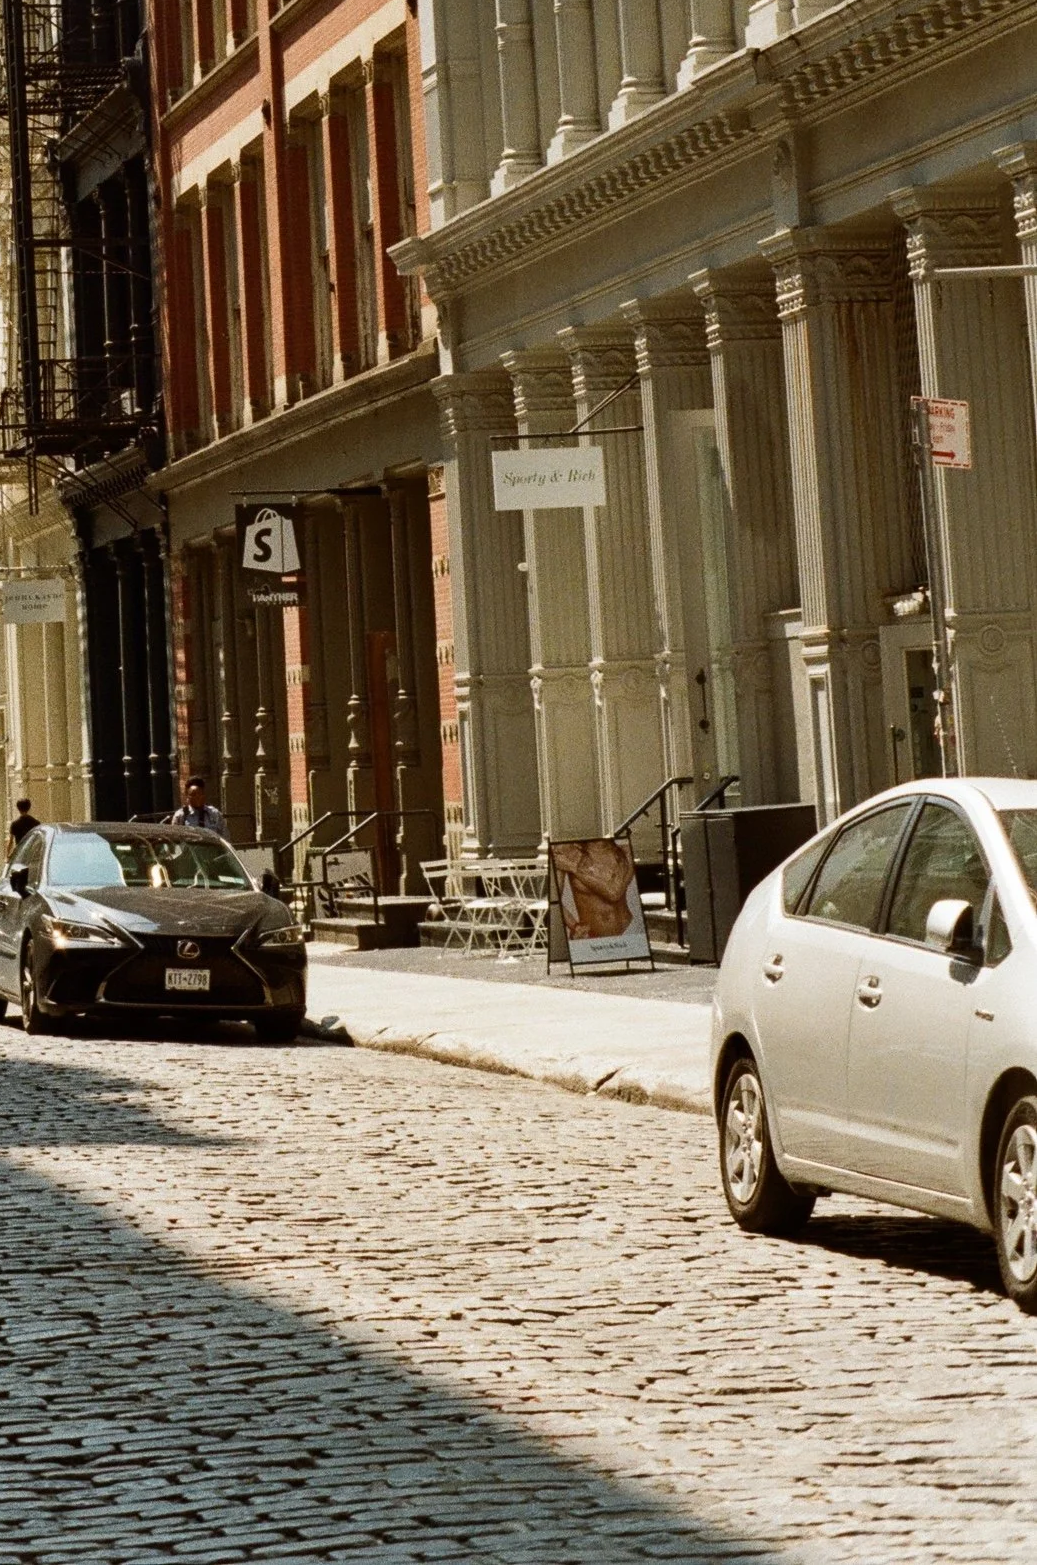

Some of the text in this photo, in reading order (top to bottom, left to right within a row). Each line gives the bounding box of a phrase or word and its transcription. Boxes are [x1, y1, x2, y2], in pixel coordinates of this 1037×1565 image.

[503, 468, 596, 487] Sporty & Rich
